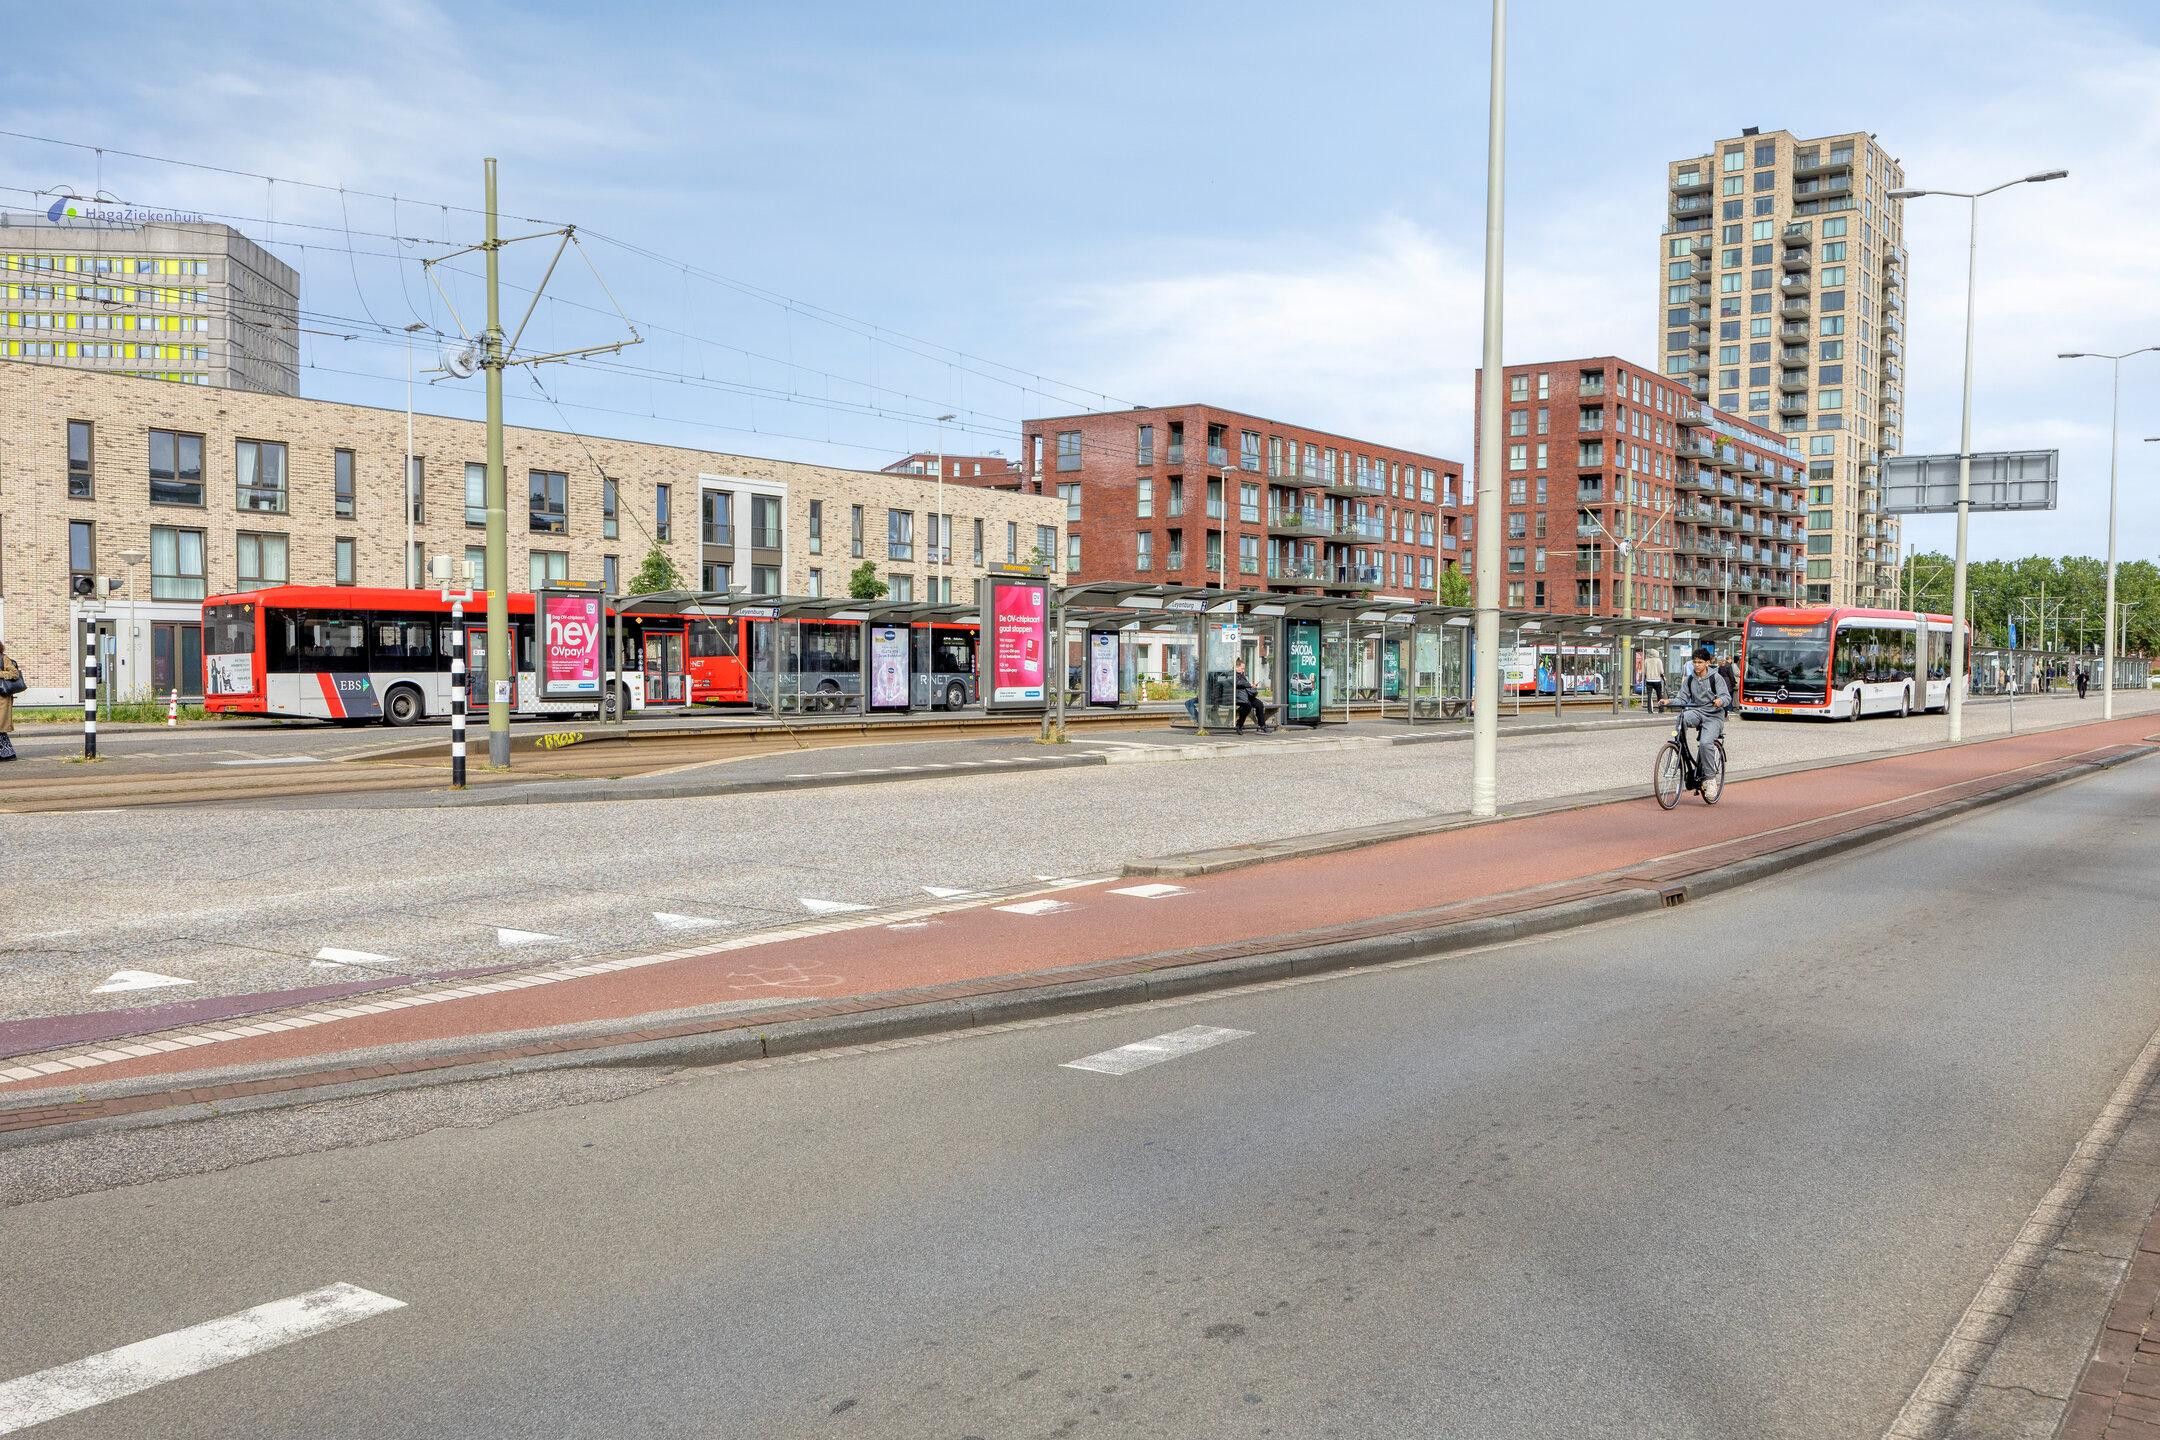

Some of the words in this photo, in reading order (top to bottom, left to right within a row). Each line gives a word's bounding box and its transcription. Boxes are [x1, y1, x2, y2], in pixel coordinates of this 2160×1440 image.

[86, 207, 204, 223] HagaZiekenhuis
[1172, 602, 1195, 610] Leyenburg
[999, 614, 1007, 622] De
[1007, 615, 1040, 624] OV-chipkaart
[546, 613, 599, 653] hey
[1012, 626, 1033, 634] stoppen
[1755, 627, 1763, 637] 23
[551, 646, 585, 658] OVpay!
[1291, 642, 1313, 656] ŠKODA
[1301, 655, 1317, 666] EPIQ
[340, 680, 362, 691] EBS
